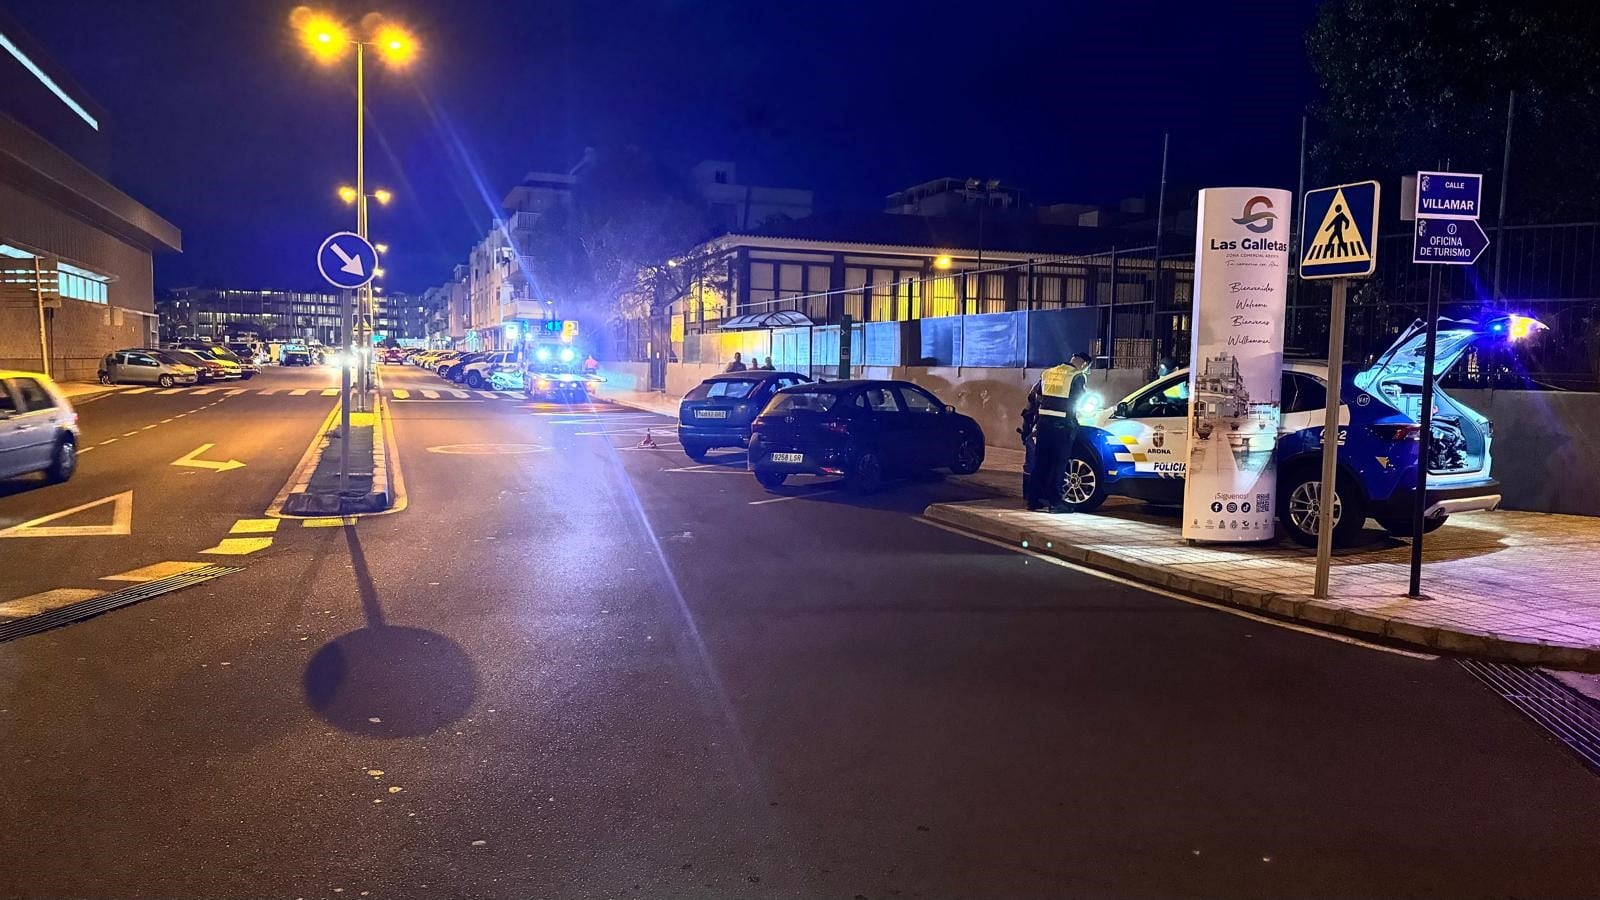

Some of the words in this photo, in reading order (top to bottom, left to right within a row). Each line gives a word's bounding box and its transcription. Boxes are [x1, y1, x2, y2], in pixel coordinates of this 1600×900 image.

[1423, 199, 1474, 210] VILLAMAR
[1211, 239, 1236, 250] Las
[1241, 238, 1287, 252] Galletas
[1430, 236, 1462, 246] OFICINA
[1420, 247, 1432, 256] DE
[1434, 248, 1471, 257] TURISMO
[1229, 282, 1274, 293] Bienvenidos
[1236, 298, 1268, 310] Welcome
